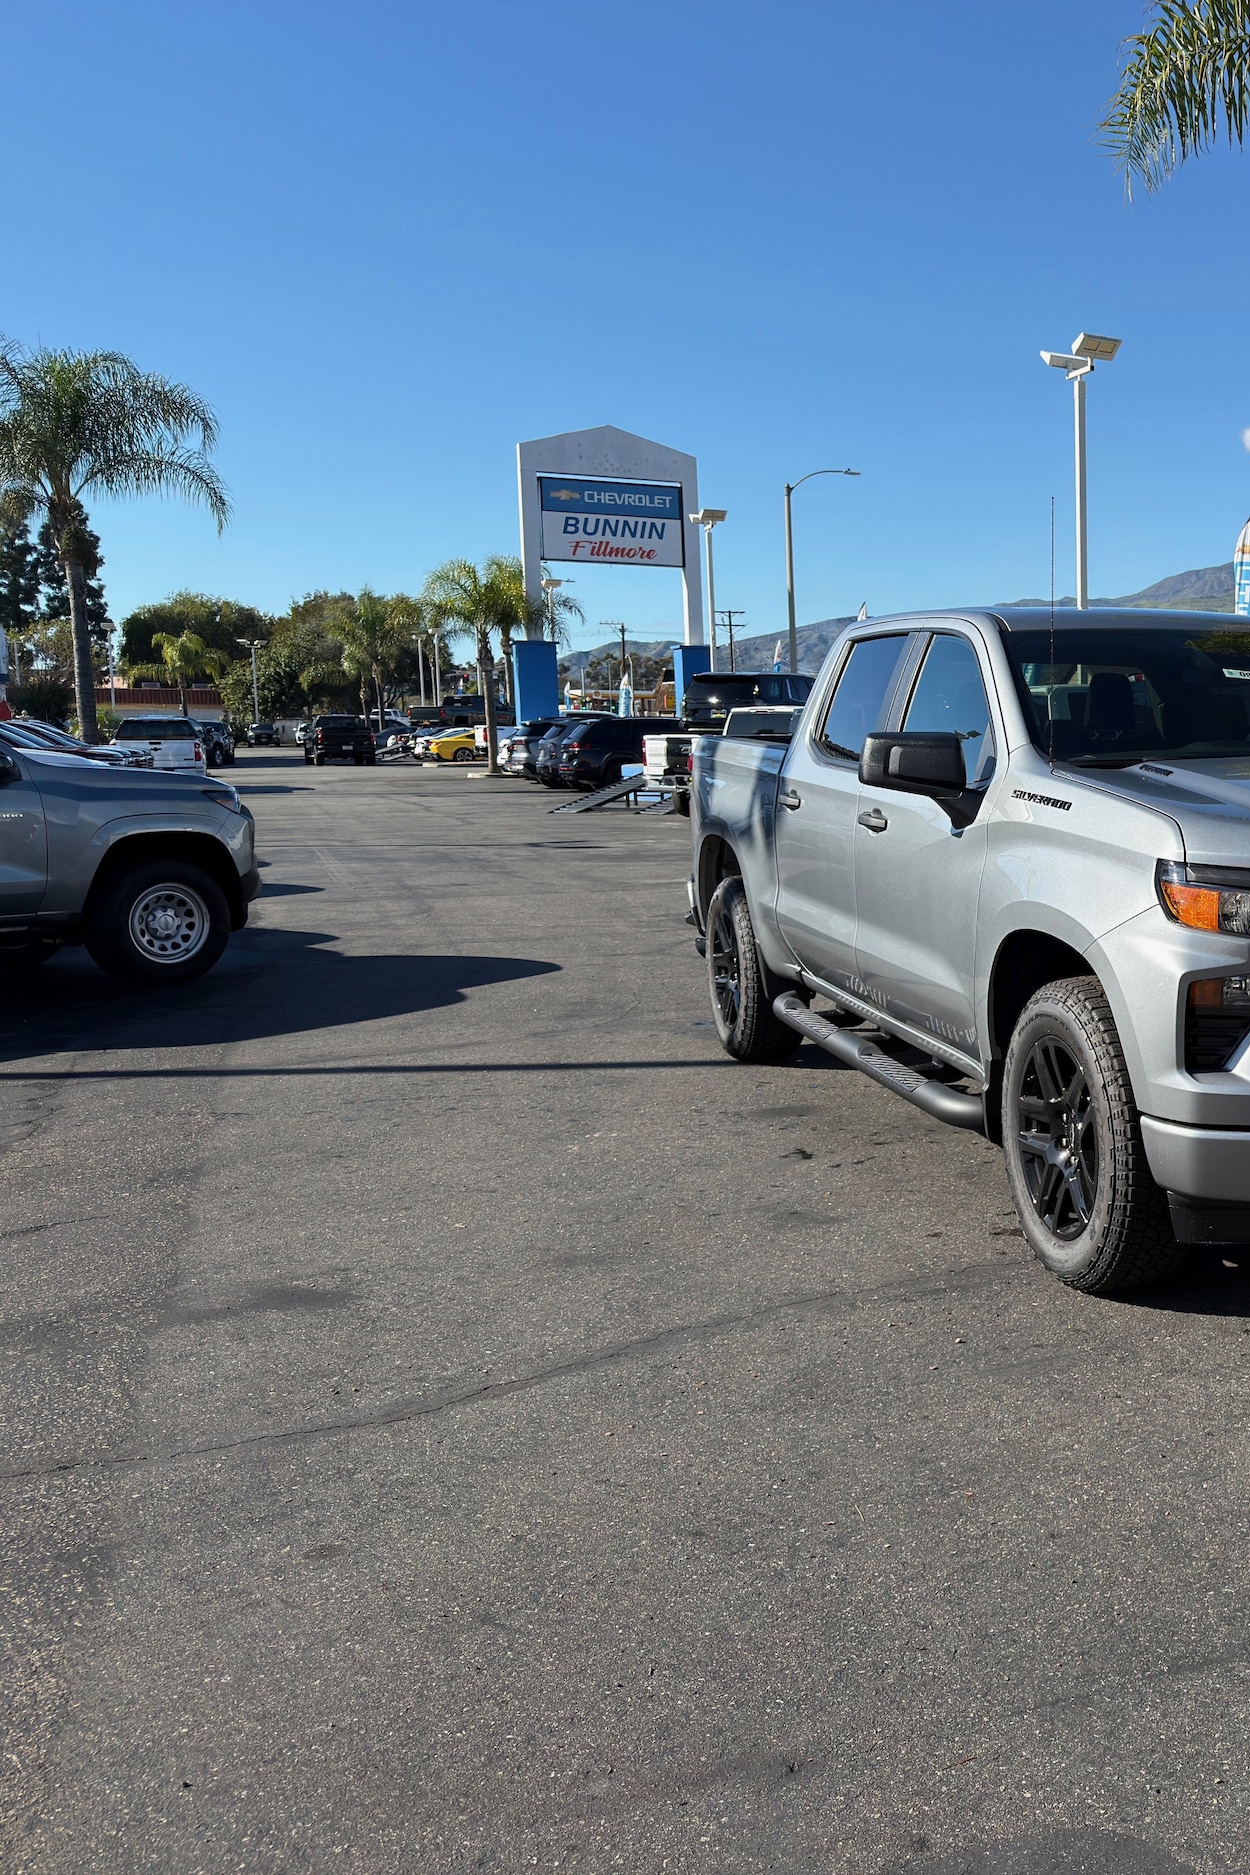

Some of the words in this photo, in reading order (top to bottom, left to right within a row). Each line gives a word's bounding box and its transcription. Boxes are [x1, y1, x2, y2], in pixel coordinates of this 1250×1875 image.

[584, 490, 672, 508] CHEVROLET
[562, 516, 666, 540] BUNNIN
[568, 540, 657, 560] Fillmore
[1011, 789, 1073, 811] SILVERADO
